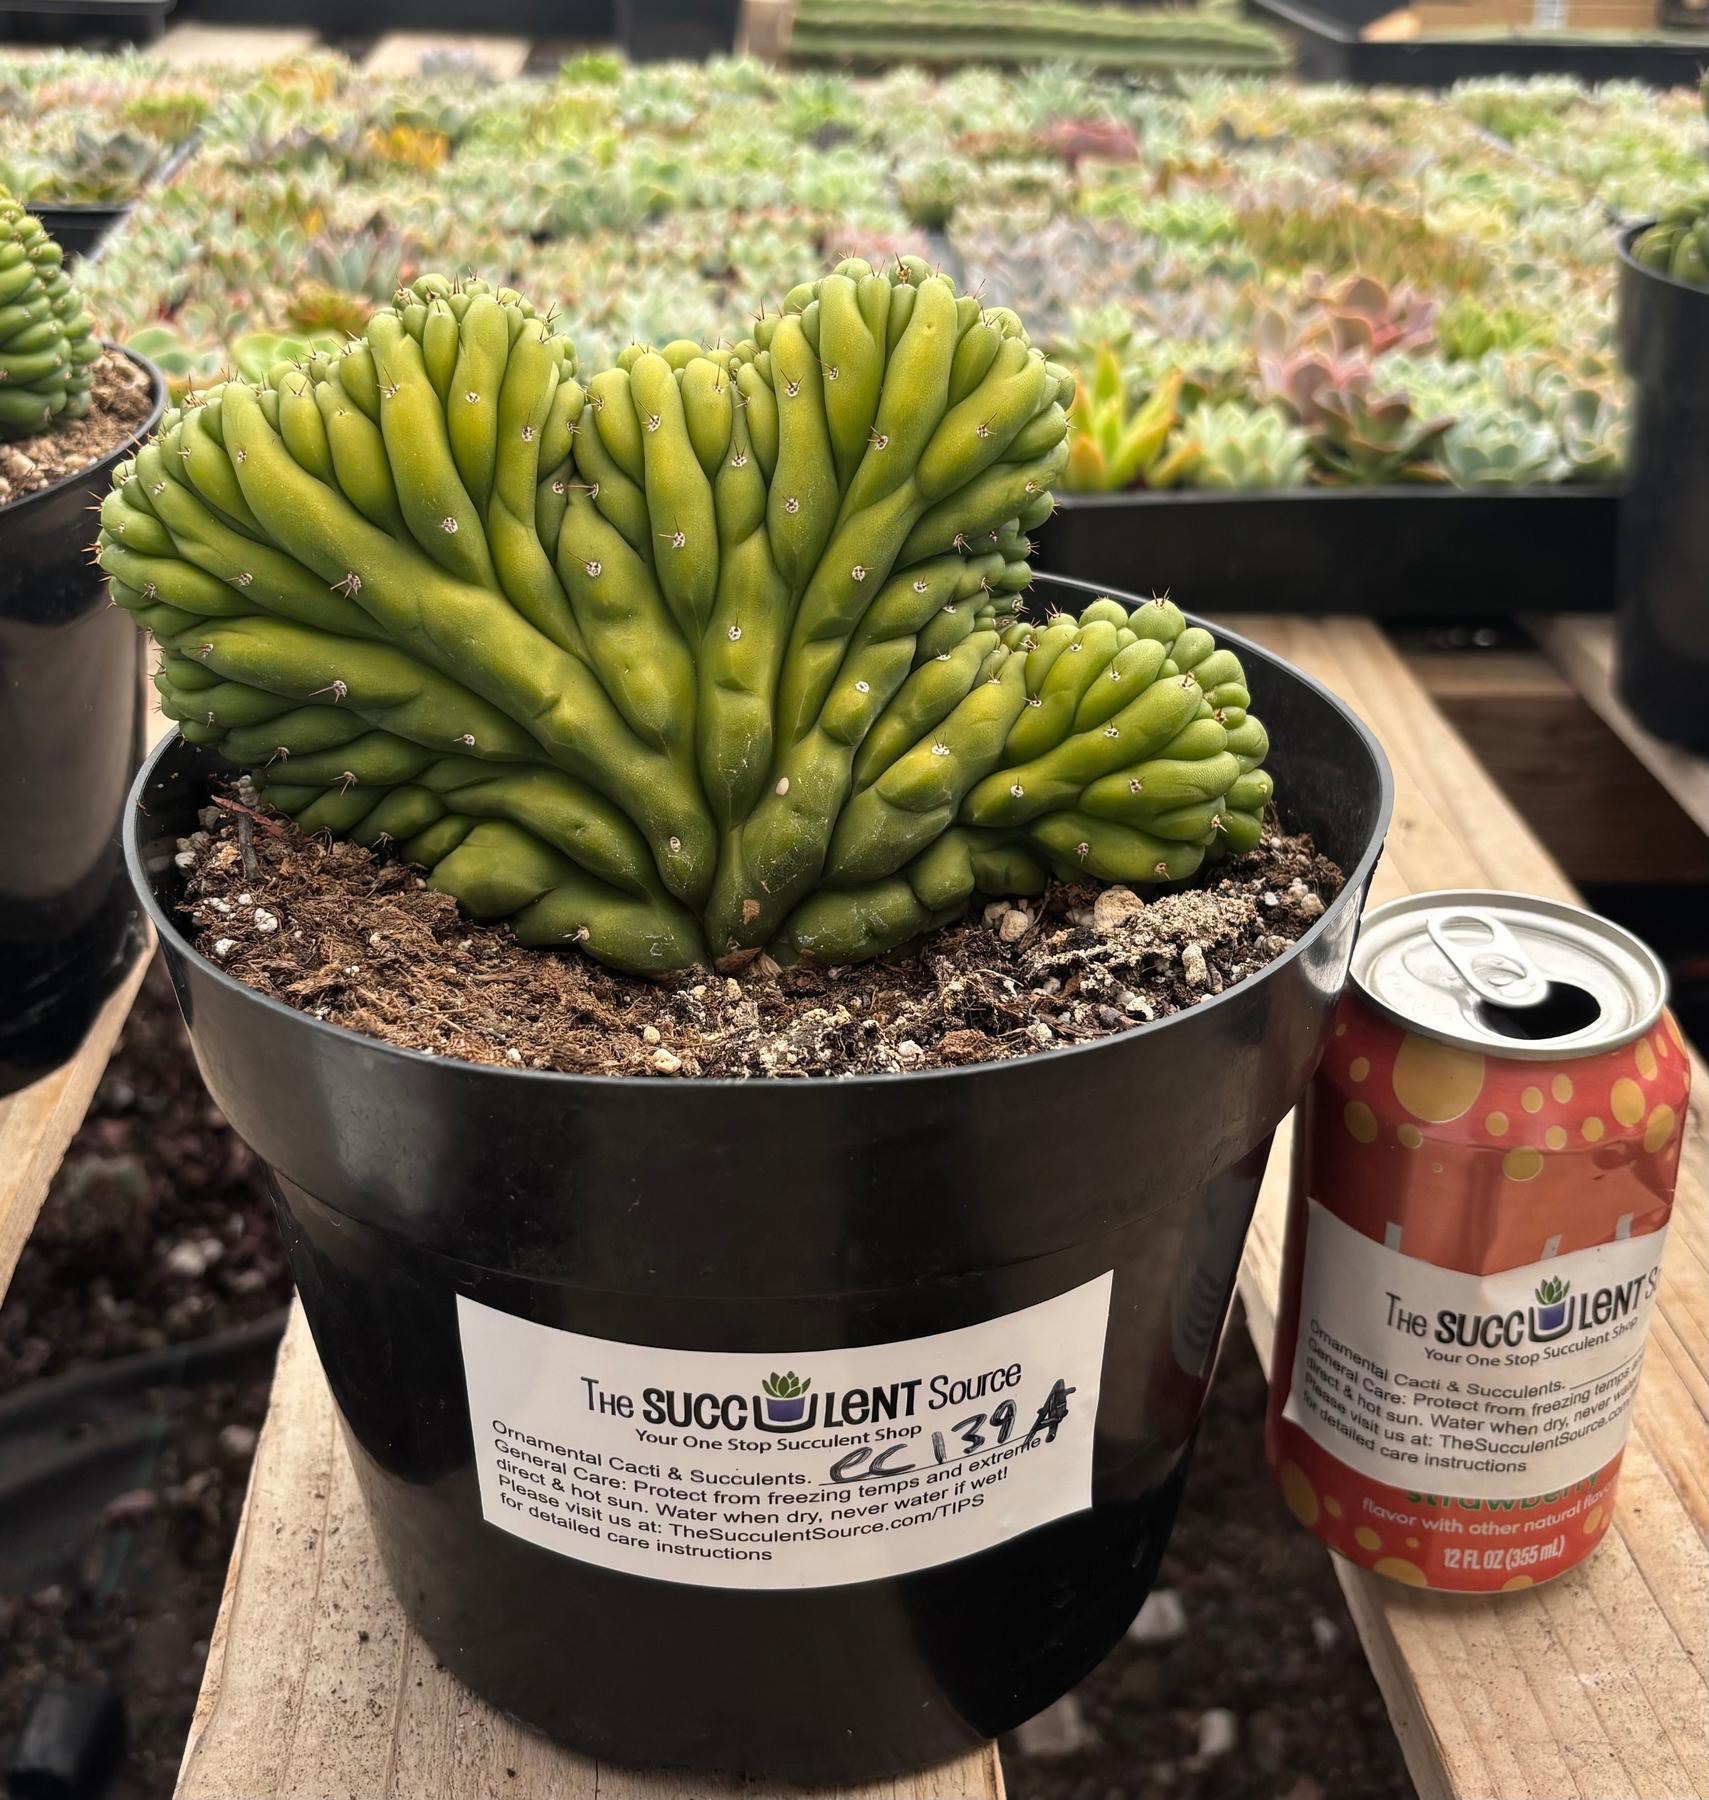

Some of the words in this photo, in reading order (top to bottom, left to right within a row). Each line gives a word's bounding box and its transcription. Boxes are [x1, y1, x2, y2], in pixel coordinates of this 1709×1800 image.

[1310, 1318, 1388, 1381] Ornamental
[1394, 1373, 1440, 1391] Cacti
[1446, 1380, 1459, 1393] &
[1466, 1379, 1565, 1399] Succulents.
[1424, 1347, 1462, 1364] Your
[1466, 1353, 1500, 1367] One
[1504, 1351, 1539, 1367] Stop
[1543, 1328, 1610, 1360] Succulent
[1612, 1316, 1638, 1340] Shop
[929, 1363, 1022, 1410] Source
[1305, 1356, 1339, 1391] direct
[1343, 1384, 1352, 1400] &
[1357, 1393, 1381, 1417] hot
[1386, 1410, 1423, 1426] sun.
[1430, 1413, 1485, 1432] Water
[1490, 1421, 1538, 1436] when
[1543, 1416, 1570, 1434] dry,
[1574, 1396, 1611, 1424] never
[1305, 1372, 1346, 1415] Please
[1350, 1410, 1379, 1434] visit
[1384, 1428, 1405, 1443] us
[1410, 1432, 1432, 1448] at:
[1308, 1337, 1358, 1382] General
[1362, 1377, 1406, 1405] Care:
[1413, 1392, 1478, 1412] Protect
[1484, 1402, 1525, 1417] from
[1532, 1389, 1590, 1417] freezing
[1594, 1366, 1630, 1396] temps
[492, 1420, 602, 1467] Ornamental
[609, 1456, 660, 1478] Cacti
[668, 1467, 682, 1481] &
[690, 1469, 812, 1487] Succulents.
[495, 1438, 567, 1475] General
[574, 1467, 626, 1490] Care:
[634, 1480, 708, 1503] Protect
[713, 1490, 760, 1505] from
[768, 1487, 851, 1505] freezing
[859, 1478, 919, 1500] temps
[926, 1465, 962, 1485] and
[969, 1437, 1041, 1472] extreme
[635, 1428, 678, 1446] Your
[683, 1435, 723, 1450] One
[727, 1438, 772, 1454] Stop
[777, 1431, 869, 1451] Succulent
[875, 1424, 922, 1442] Shop
[1320, 1407, 1375, 1451] detailed
[1379, 1446, 1418, 1463] care
[1424, 1452, 1527, 1474] instructions
[496, 1457, 546, 1486] direct
[552, 1478, 565, 1493] &
[571, 1483, 602, 1503] hot
[607, 1495, 648, 1514] sun.
[655, 1502, 717, 1522] Water
[723, 1510, 779, 1524] when
[786, 1509, 823, 1526] dry,
[831, 1501, 888, 1521] never
[895, 1488, 947, 1510] water
[954, 1480, 967, 1497] if
[970, 1466, 1008, 1491] wet!
[499, 1474, 560, 1508] Please
[565, 1500, 602, 1522] visit
[609, 1513, 632, 1528] us
[638, 1518, 662, 1534] at:
[668, 1493, 985, 1543] TheSucculentSource.com/TIPS
[500, 1490, 523, 1512] for
[528, 1504, 601, 1538] detailed
[607, 1532, 650, 1550] care
[656, 1539, 773, 1561] instructions
[1362, 1497, 1416, 1526] flavor
[1422, 1514, 1464, 1534] with
[1469, 1520, 1521, 1536] other
[1524, 1501, 1582, 1532] natural
[1443, 1548, 1459, 1569] 12
[1463, 1549, 1480, 1570] FL
[1483, 1549, 1504, 1570] OZ
[1505, 1545, 1539, 1571] (355
[1540, 1535, 1566, 1562] mL)
